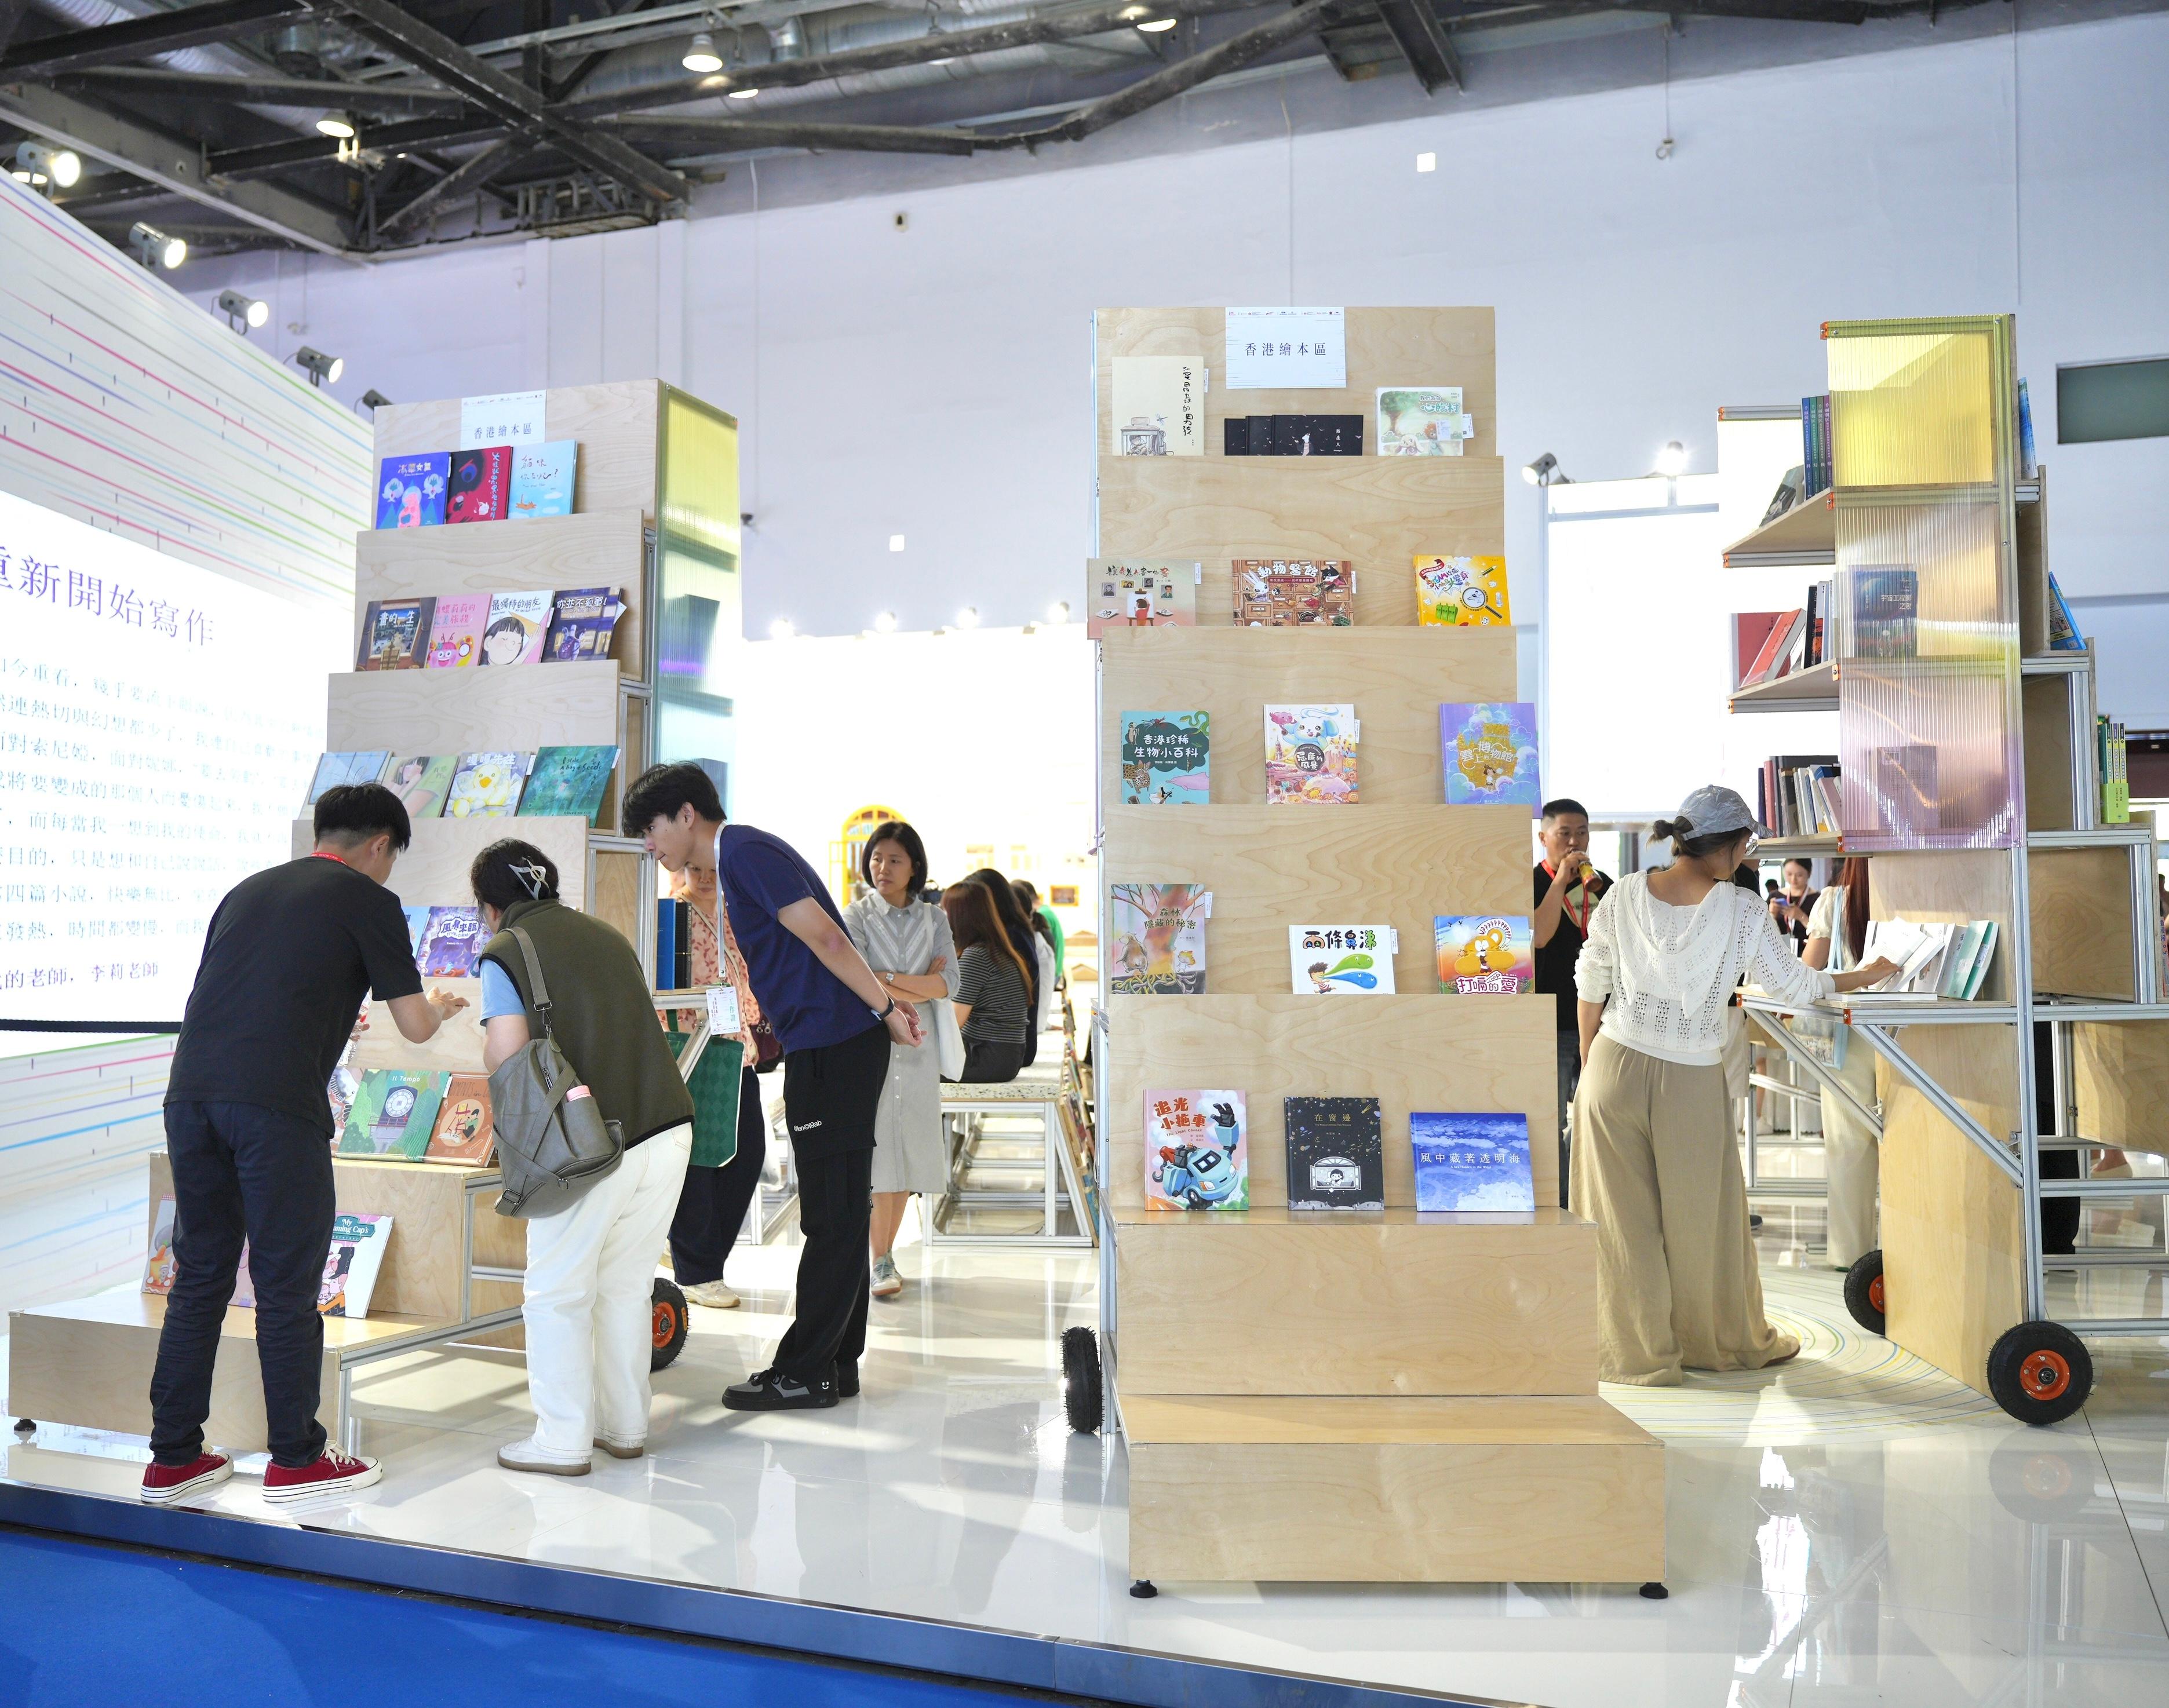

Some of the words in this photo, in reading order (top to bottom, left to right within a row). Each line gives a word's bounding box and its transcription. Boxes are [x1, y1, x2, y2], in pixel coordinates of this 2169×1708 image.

[1245, 342, 1326, 356] 香港繪本區
[474, 422, 532, 440] 香港繪本區
[1257, 563, 1318, 579] 動物醫館
[491, 596, 541, 611] 最獨特的朋友
[379, 610, 415, 626] 畫的一生
[1143, 734, 1189, 745] 香港珍稀
[1134, 747, 1198, 758] 生物小百科
[1478, 741, 1514, 762] 博物館
[466, 753, 516, 765] 嘎嘎先生
[1300, 761, 1318, 771] 風景
[1160, 907, 1181, 917] 森林
[440, 919, 477, 933] 風暴來臨
[1144, 918, 1196, 929] 隱藏的秘密
[1302, 929, 1377, 950] 兩條鼻涕
[1457, 977, 1516, 992] 打嗝的愛
[1153, 1097, 1188, 1117] 追光
[1161, 1113, 1206, 1130] 小拖車
[1314, 1113, 1351, 1122] 在窗邊
[1420, 1152, 1521, 1164] 風中藏著透明海
[341, 1218, 352, 1227] My
[352, 1225, 369, 1233] Cap's
